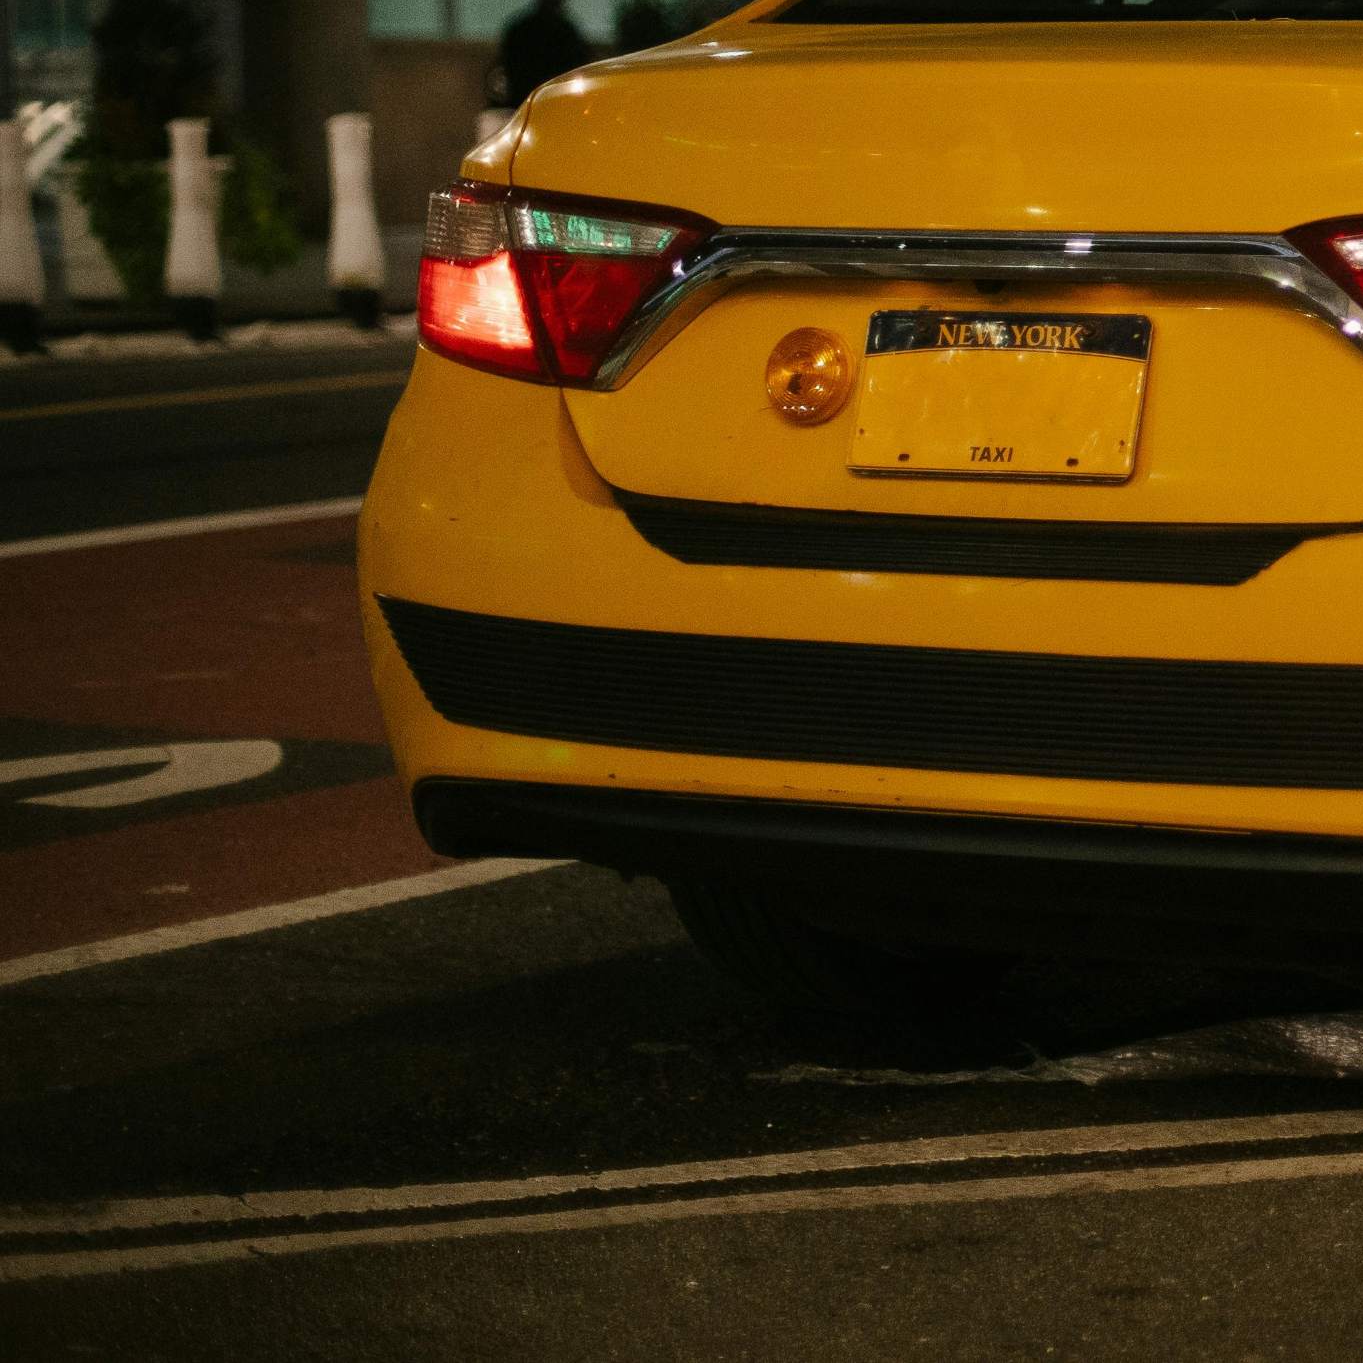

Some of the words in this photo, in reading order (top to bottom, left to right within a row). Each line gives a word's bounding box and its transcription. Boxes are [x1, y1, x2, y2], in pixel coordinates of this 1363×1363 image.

[936, 322, 1006, 348] NEW
[1011, 324, 1083, 350] YORK
[969, 446, 1014, 463] TAXI
